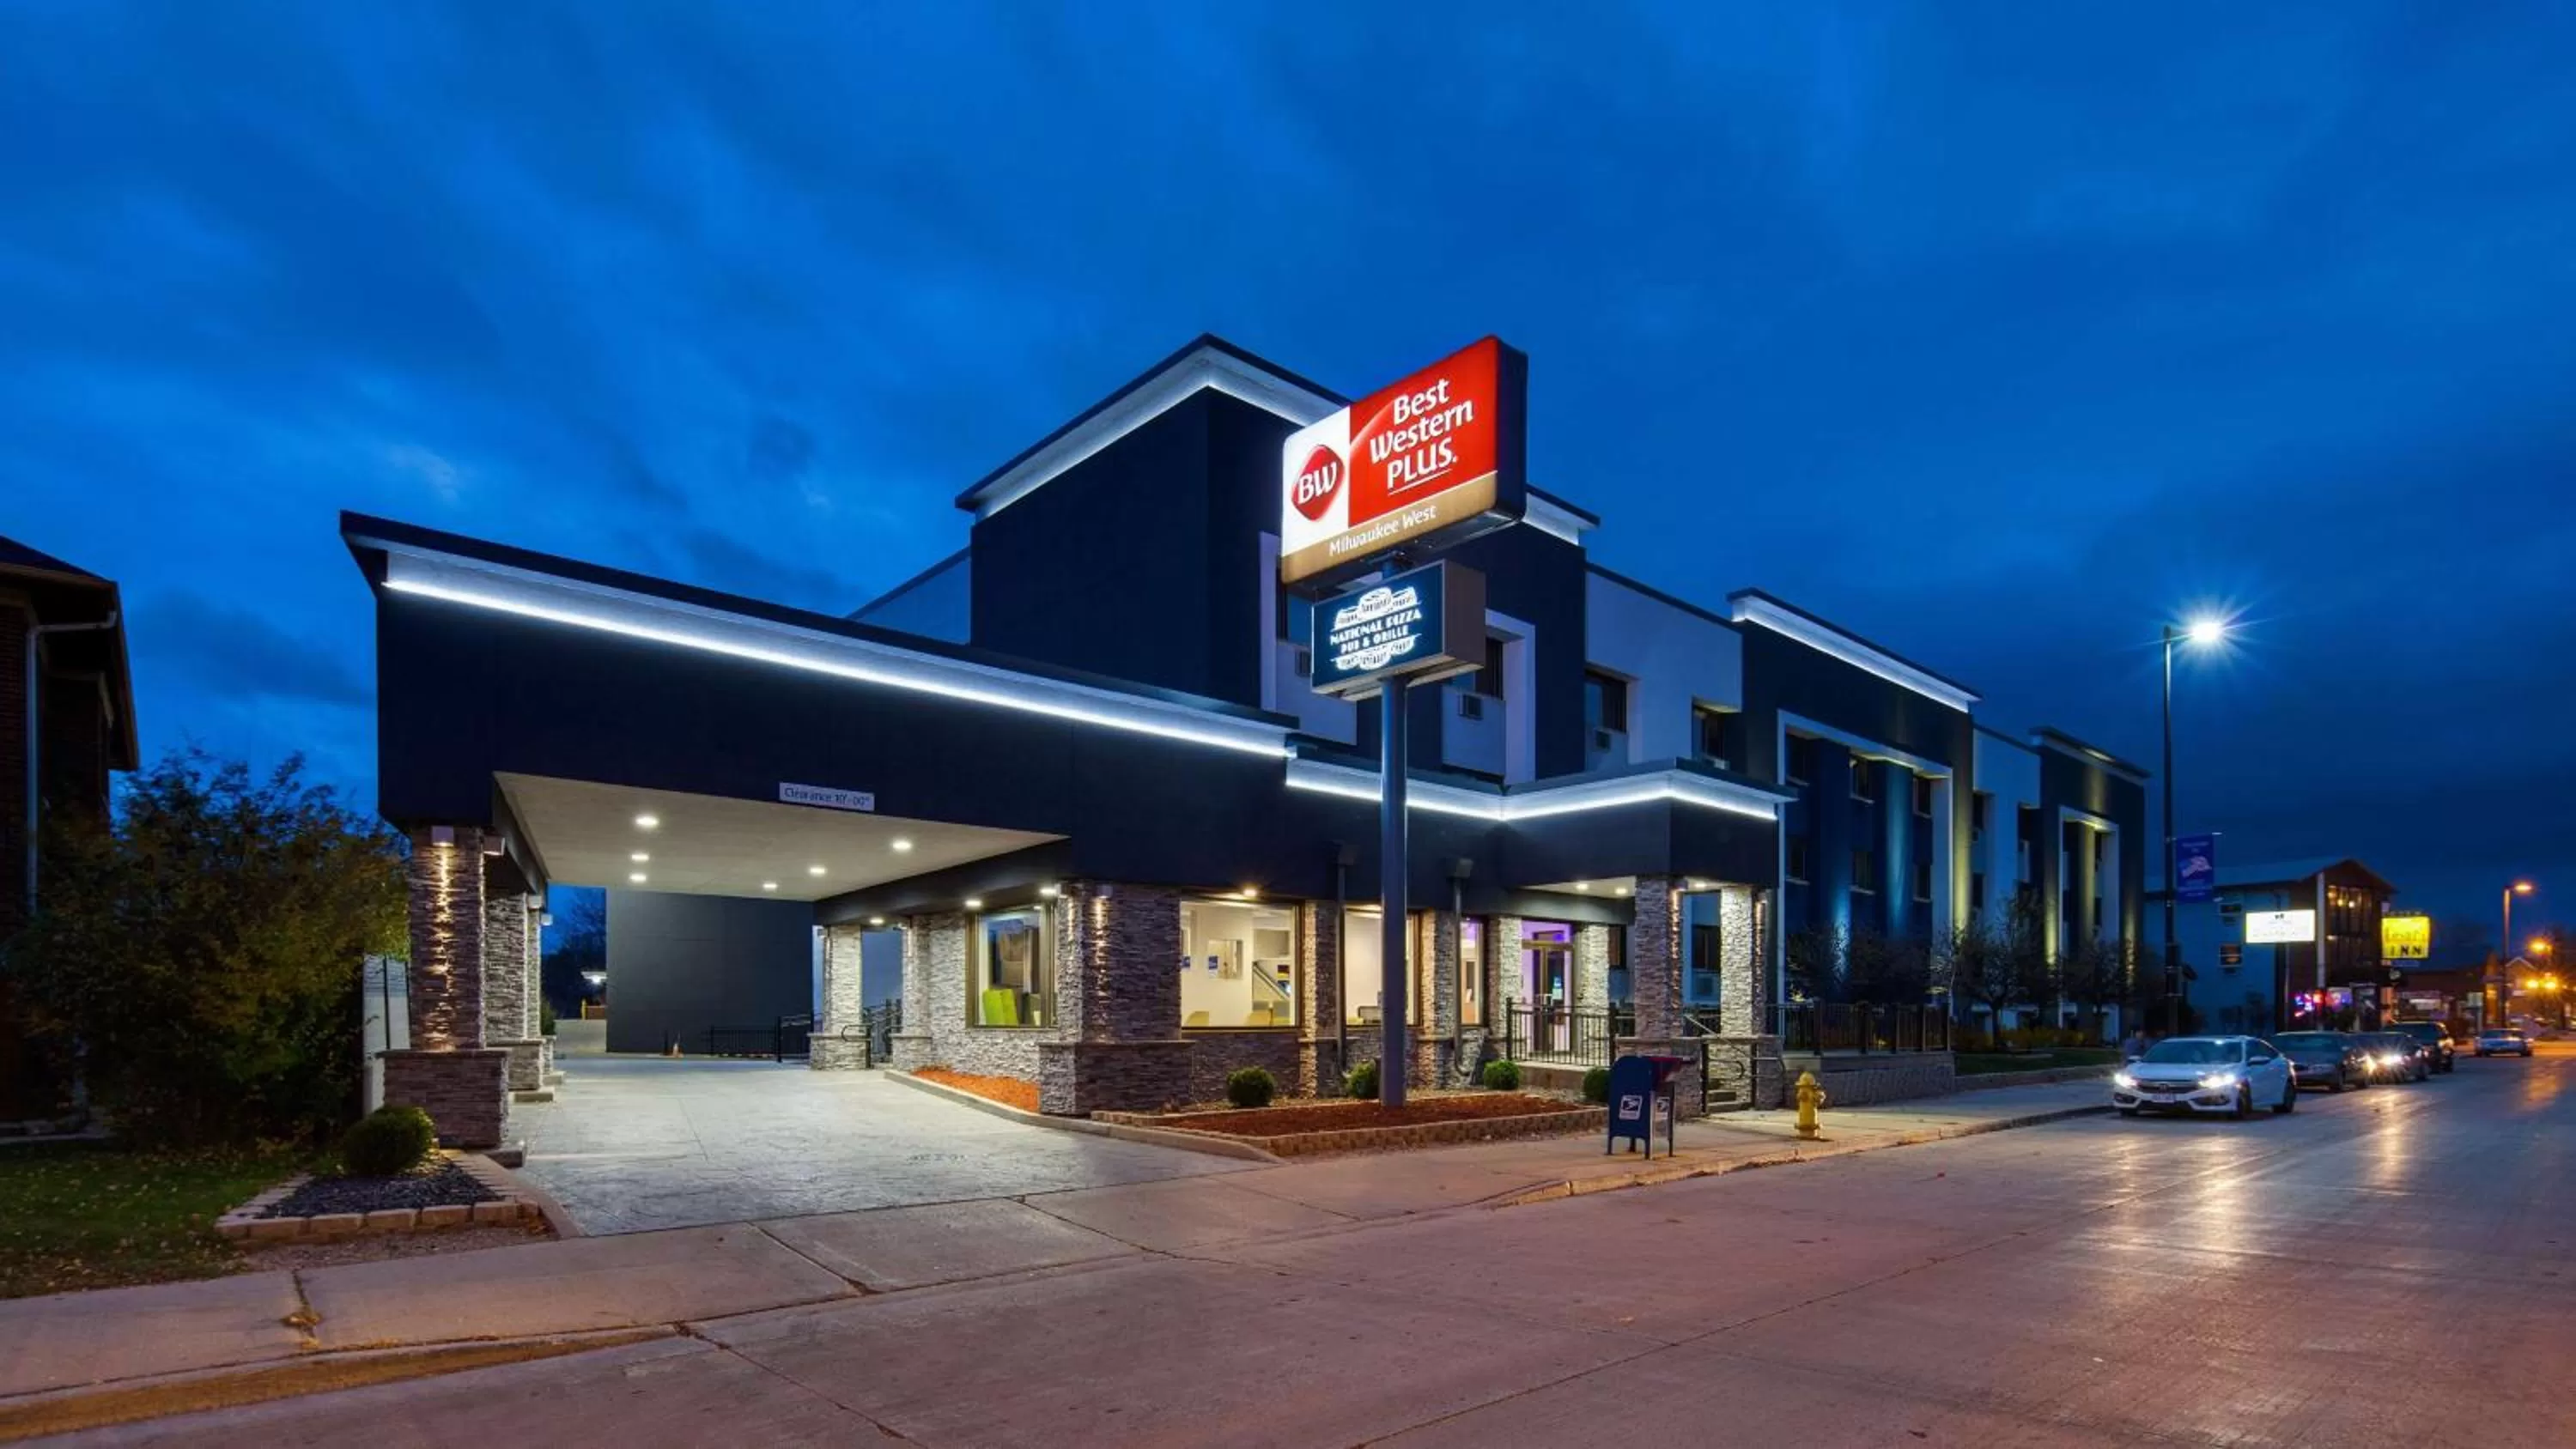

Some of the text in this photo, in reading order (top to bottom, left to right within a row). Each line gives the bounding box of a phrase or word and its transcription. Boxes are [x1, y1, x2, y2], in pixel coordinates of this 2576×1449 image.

[1394, 378, 1450, 426] Best
[1370, 399, 1473, 464] Western
[1297, 460, 1338, 505] BW
[1328, 504, 1437, 556] Milwaukee West
[1330, 620, 1382, 646] NATIONAL
[1386, 609, 1422, 628] PIZZA
[1340, 625, 1409, 654] PUB & GRILLE
[2390, 944, 2423, 957] INN
